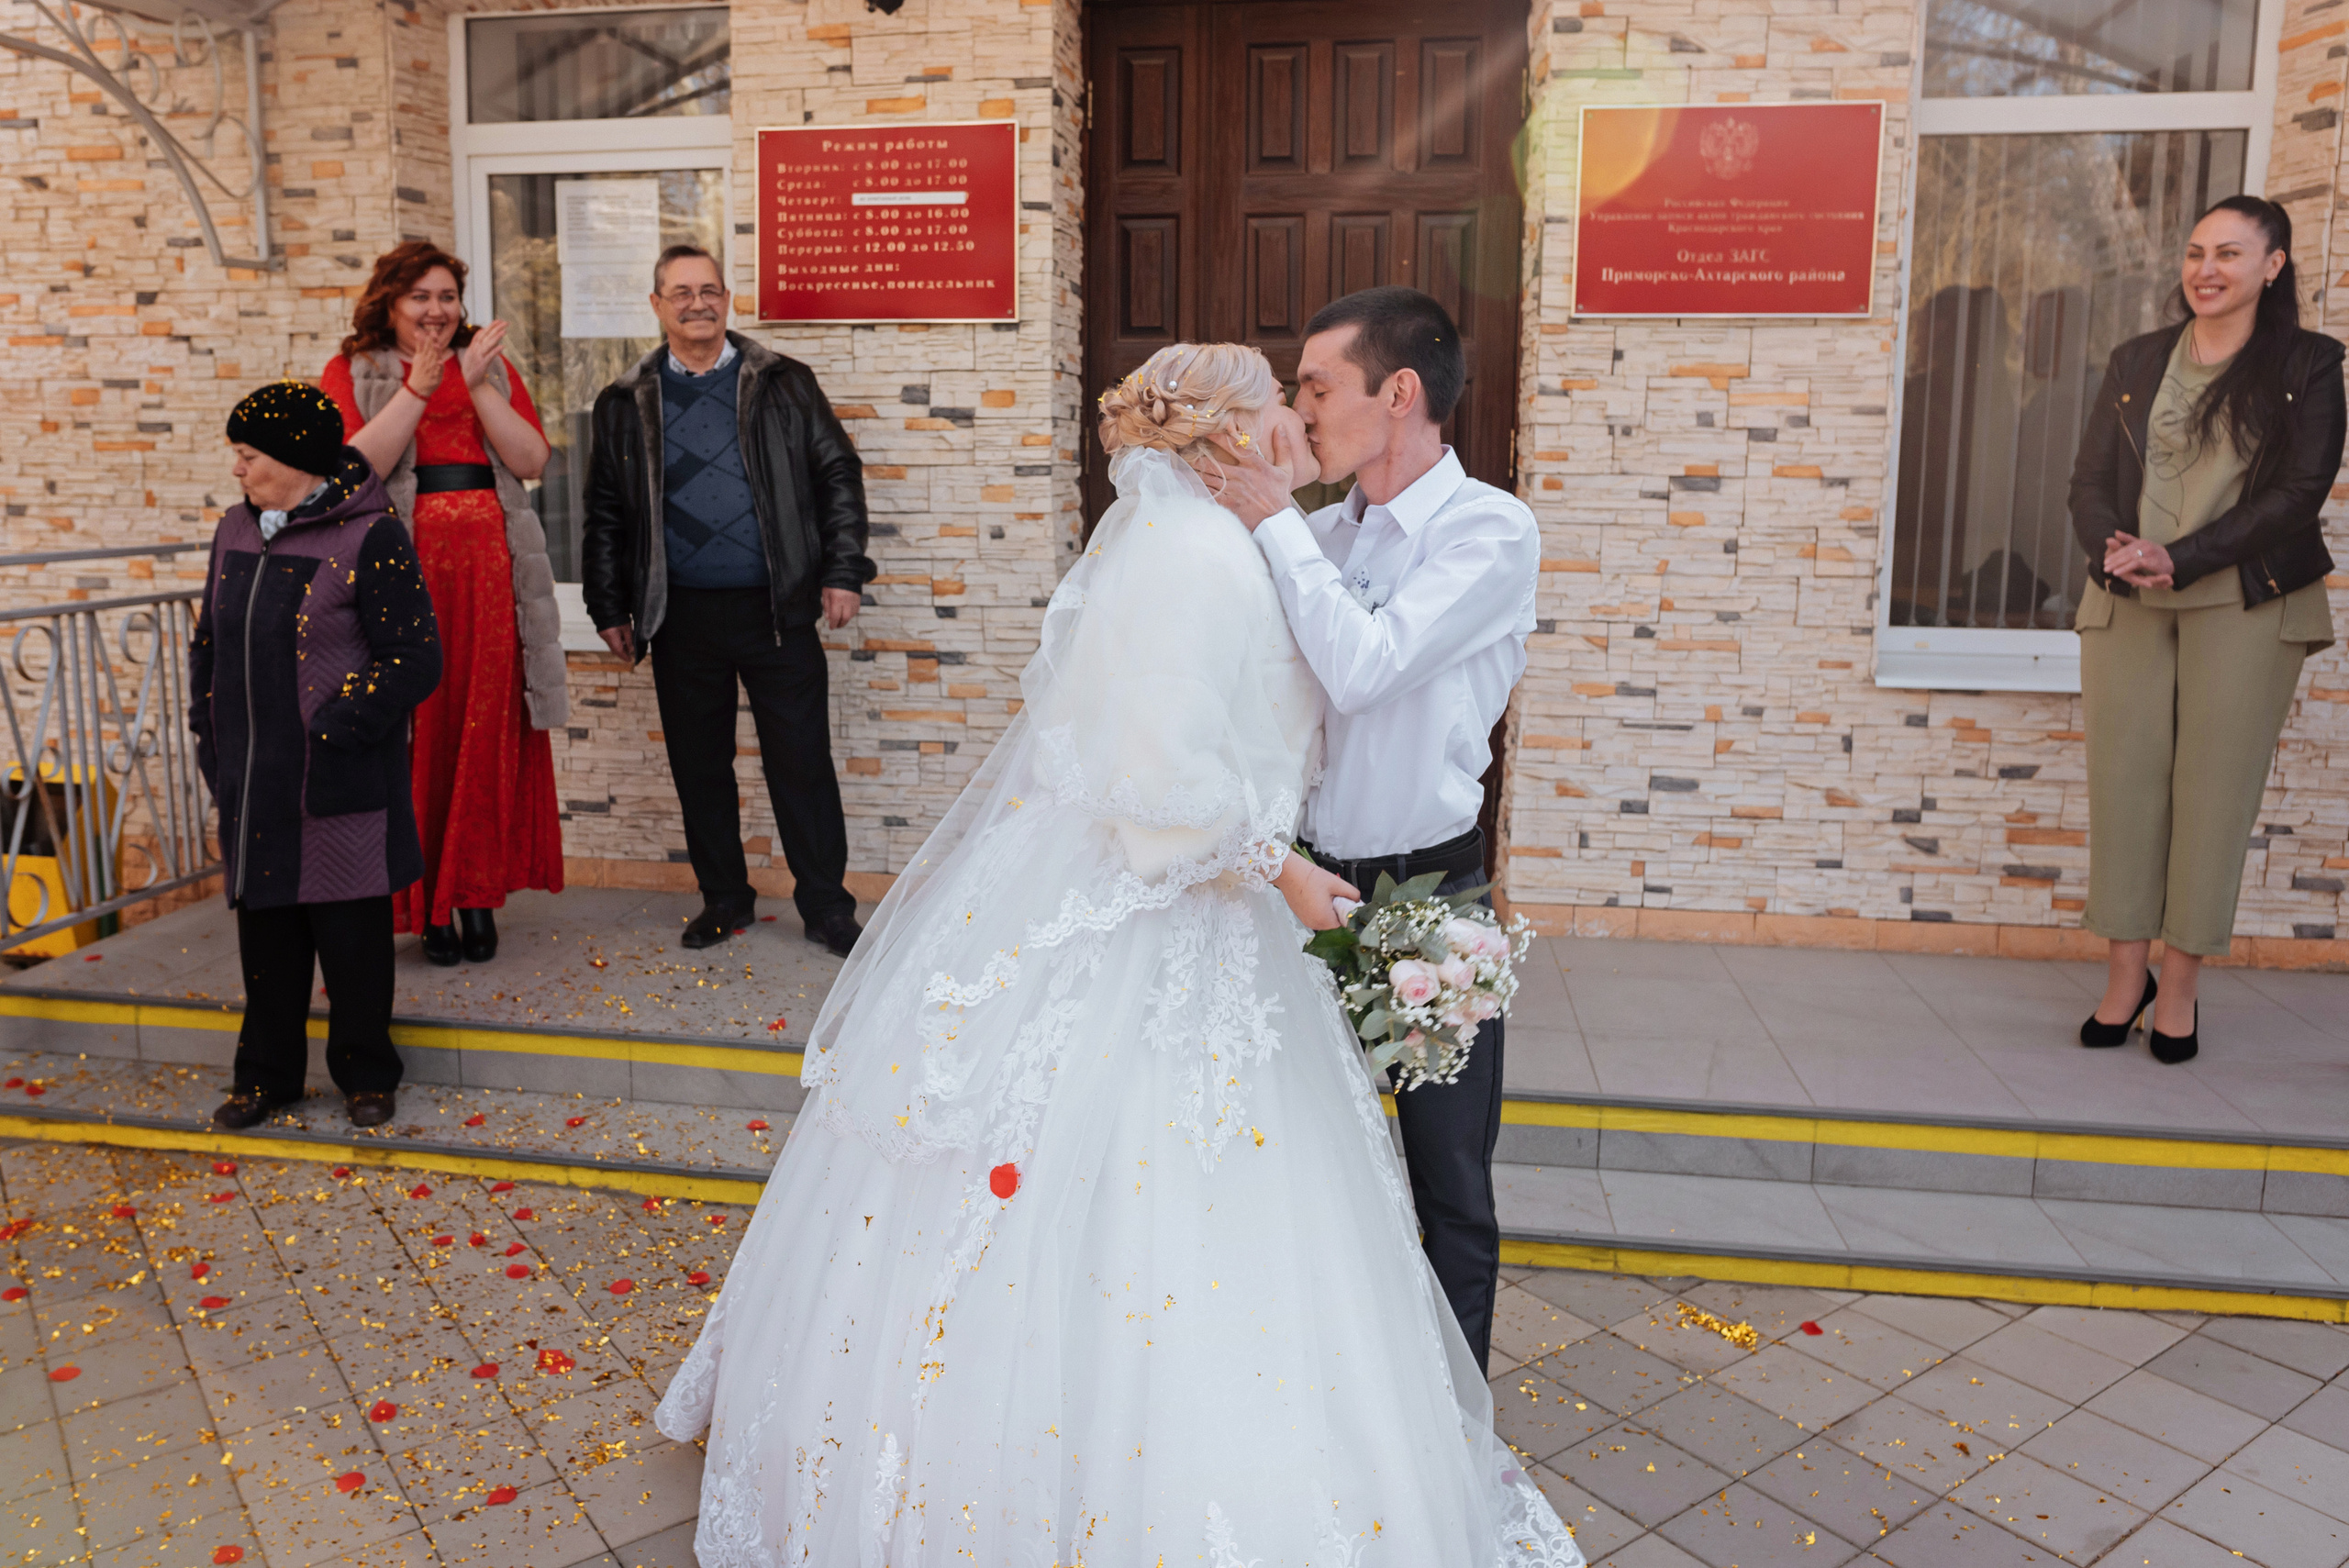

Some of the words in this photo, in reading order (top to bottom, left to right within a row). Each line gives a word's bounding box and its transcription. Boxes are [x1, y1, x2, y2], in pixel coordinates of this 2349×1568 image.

[822, 139, 878, 152] Режим
[885, 138, 948, 153] работы
[865, 209, 899, 220] 8.00
[865, 225, 899, 236] 8.00
[928, 224, 968, 235] 17.00
[865, 241, 907, 252] 12.00
[1677, 248, 1723, 264] Отдел
[1730, 248, 1770, 263] ЗАГС
[778, 264, 859, 274] Выходные
[1601, 267, 1784, 285] Приморско-Ахтарского
[1789, 268, 1846, 284] района
